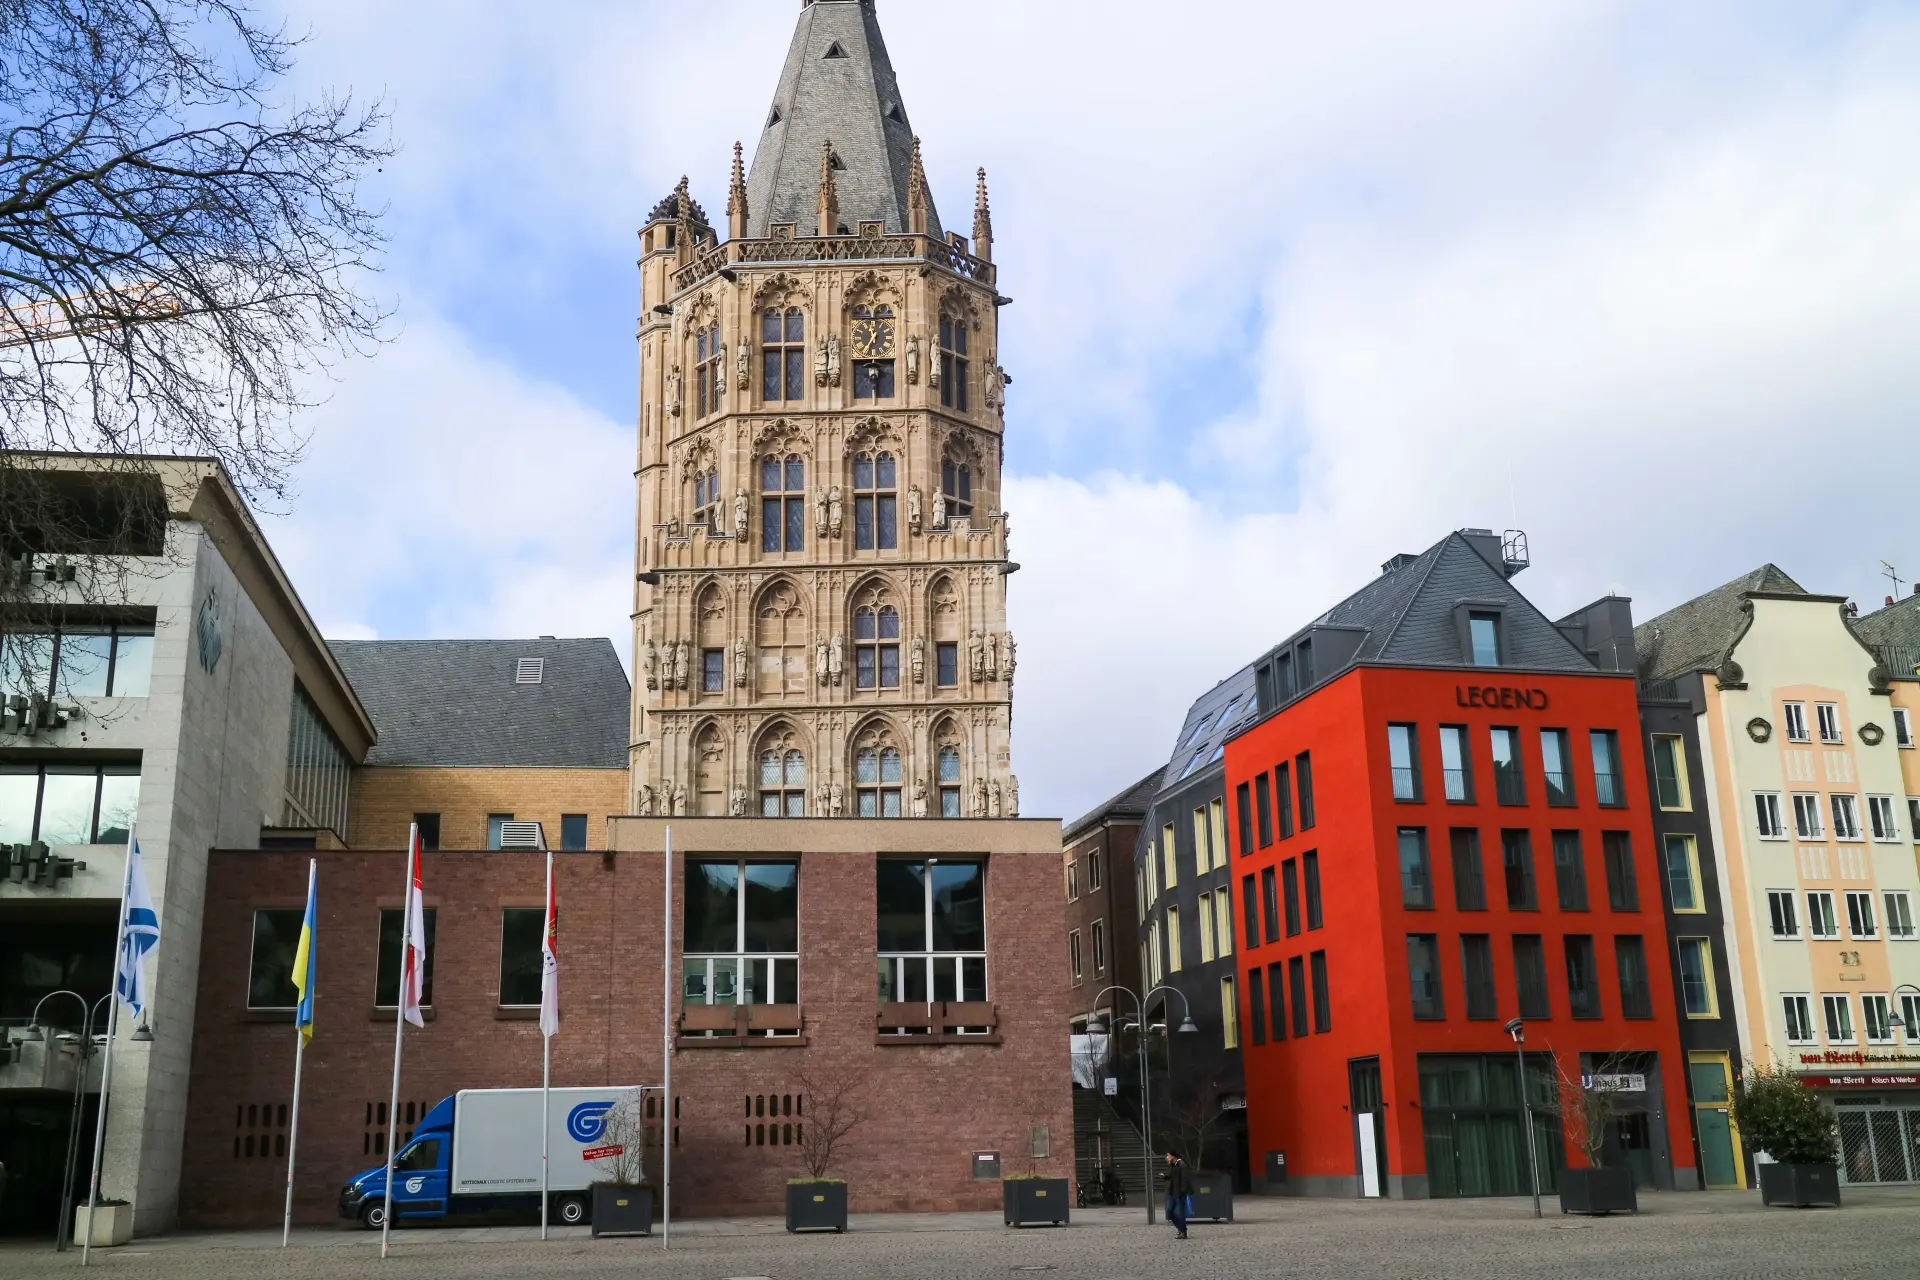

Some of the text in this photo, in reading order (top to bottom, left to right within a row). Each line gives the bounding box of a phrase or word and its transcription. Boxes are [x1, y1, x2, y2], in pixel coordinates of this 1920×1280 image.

[1456, 686, 1548, 710] LEGEND
[1800, 1053, 1821, 1064] von
[1824, 1050, 1863, 1066] Werth
[1864, 1054, 1888, 1063] Kölsch
[1890, 1054, 1897, 1062] &
[1843, 1076, 1865, 1084] Werth
[1871, 1076, 1890, 1084] Kölsch
